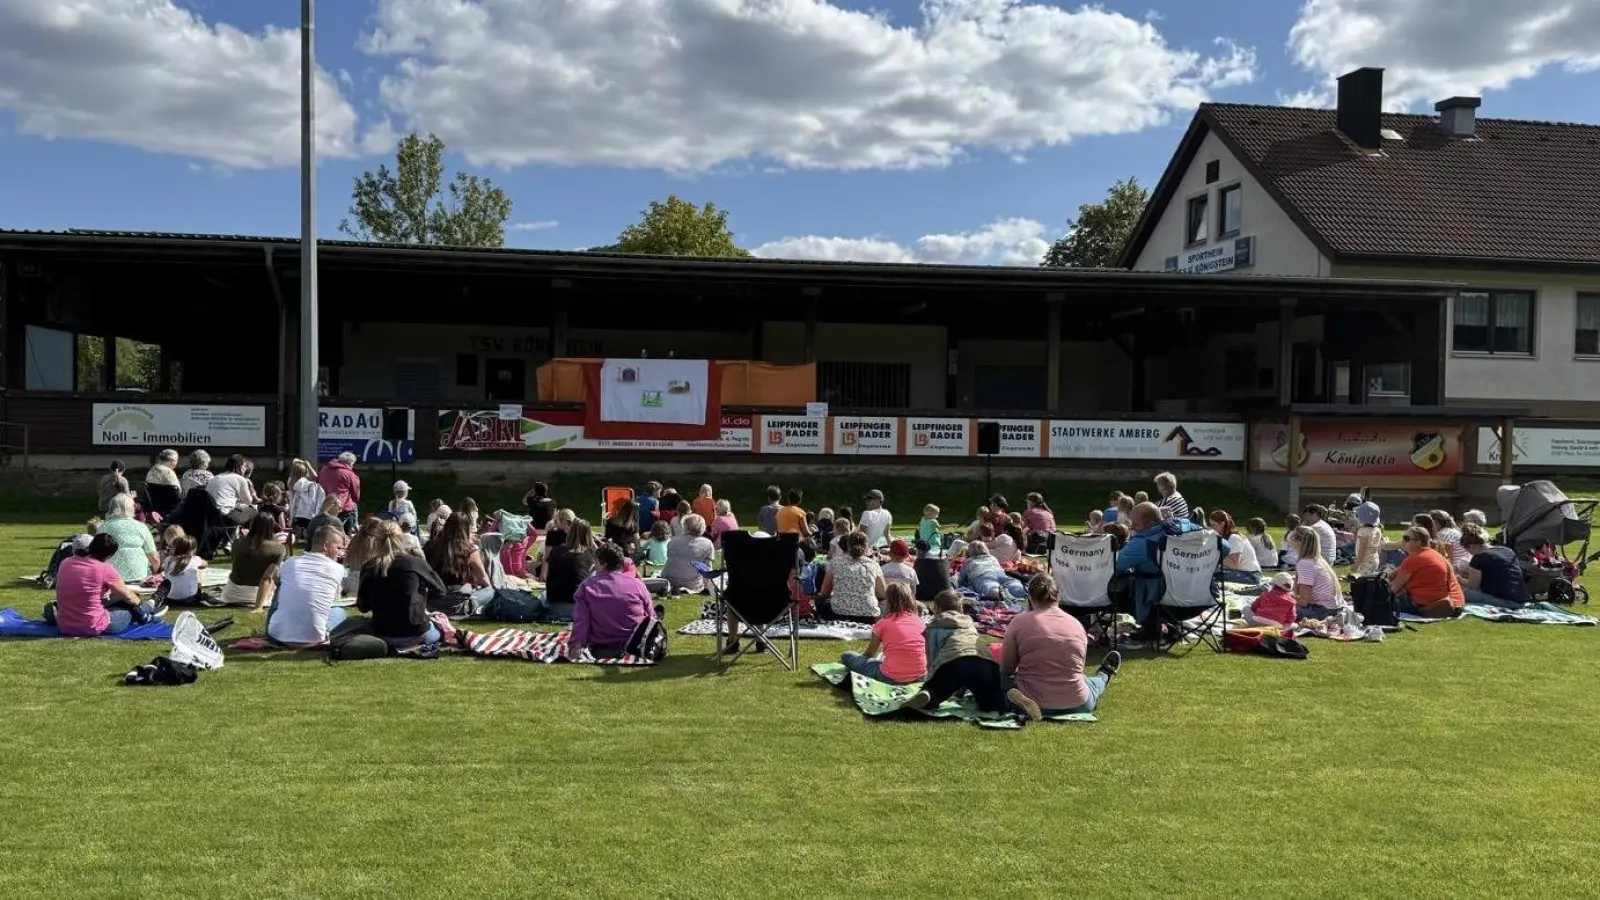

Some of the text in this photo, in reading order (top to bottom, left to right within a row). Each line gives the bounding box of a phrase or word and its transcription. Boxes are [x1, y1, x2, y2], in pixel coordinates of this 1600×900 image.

[468, 334, 504, 352] TSV
[767, 421, 818, 429] LEIPFINGER
[840, 422, 891, 430] LEIPFINGER
[912, 423, 963, 431] LEIPFINGER
[785, 430, 819, 438] BADER
[859, 431, 891, 439] BADER
[930, 431, 963, 440] BADER
[1002, 432, 1035, 441] BADER
[1051, 426, 1160, 439] STADTWERKE AMBERG
[102, 431, 127, 442] Noll
[143, 432, 212, 444] Immobilien
[1324, 449, 1396, 468] Königstein
[1061, 545, 1104, 558] Germany
[1172, 547, 1213, 560] Germany
